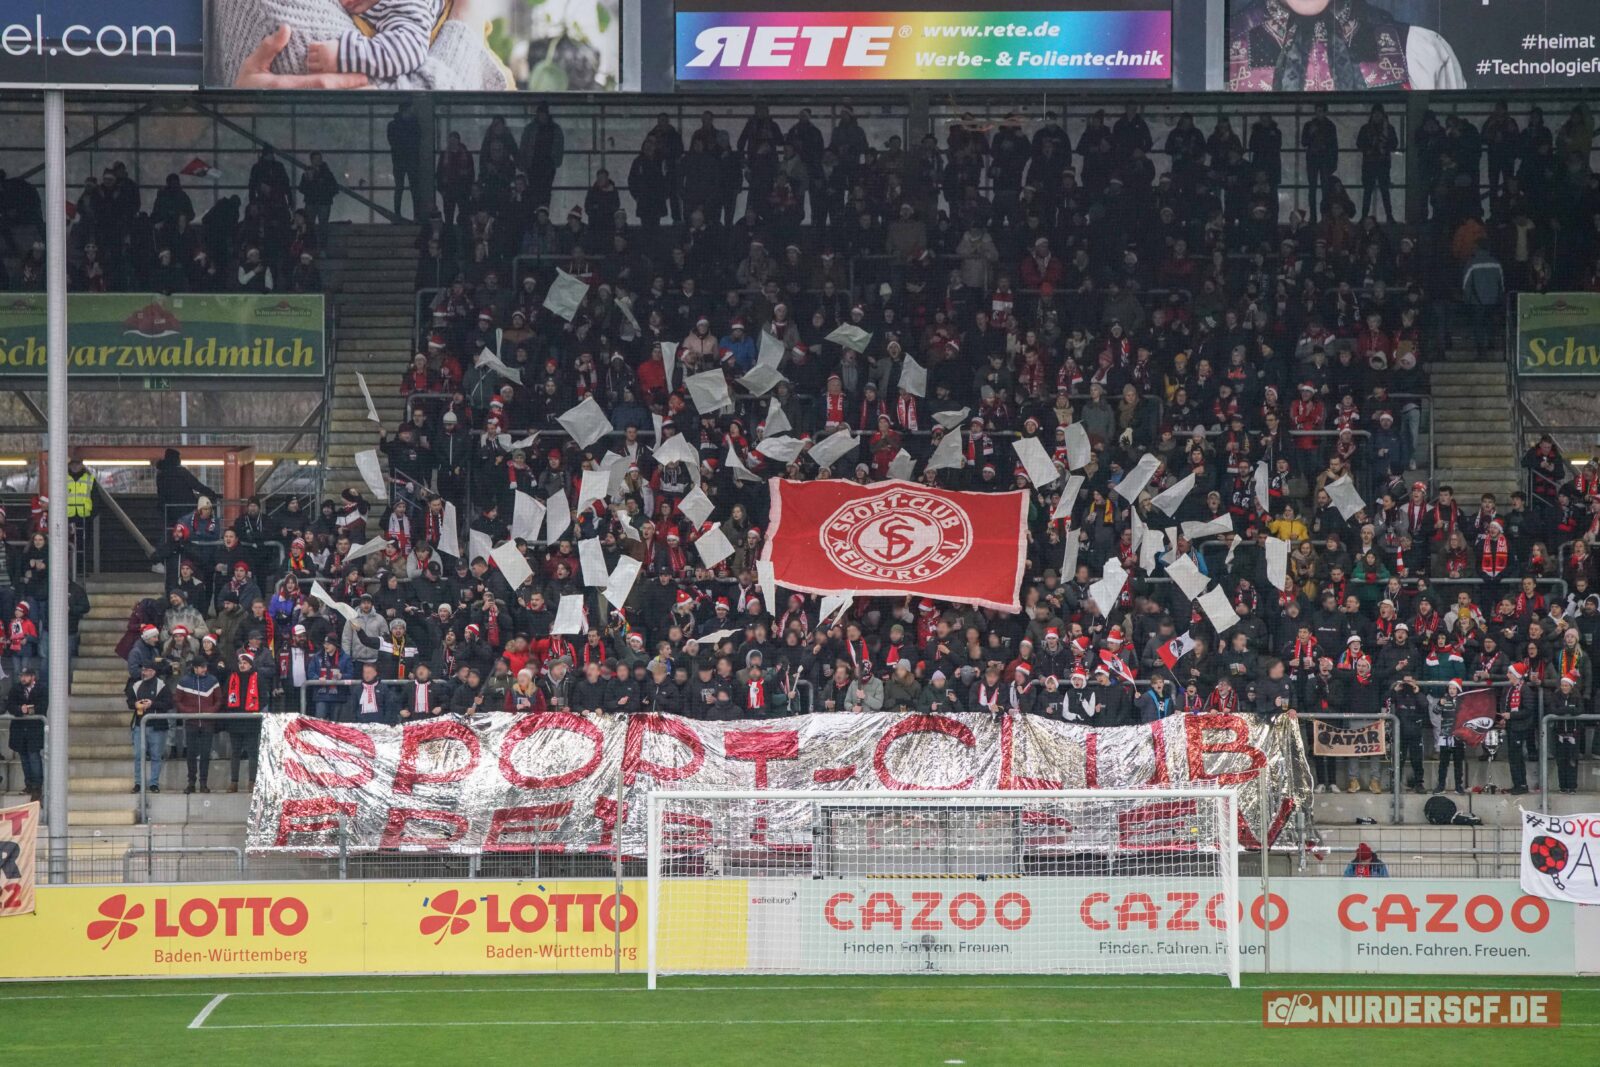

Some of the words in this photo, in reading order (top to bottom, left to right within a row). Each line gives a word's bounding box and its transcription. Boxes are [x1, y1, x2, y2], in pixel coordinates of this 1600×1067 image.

[923, 22, 1060, 38] www.rete.de
[1521, 34, 1595, 49] #heimat
[685, 26, 893, 66] RETE
[915, 51, 992, 68] Werbe-
[996, 51, 1012, 67] &
[1017, 49, 1164, 68] Folientechnik
[832, 494, 961, 533] SPORT-CLUB
[829, 536, 931, 580] REIBURG
[284, 712, 1268, 790] SPORT-CLUB
[1318, 730, 1380, 748] QATAR
[1354, 745, 1381, 753] 2022
[155, 897, 309, 937] LOTTO
[486, 894, 638, 933] LOTTO
[824, 892, 1032, 931] CAZOO
[1080, 892, 1289, 931] CAZOO
[1337, 893, 1550, 933] CAZOO
[154, 949, 307, 964] Baden-Württemberg
[843, 942, 897, 954] Finden.
[959, 942, 1013, 954] Freuen.
[1100, 942, 1153, 955] Finden.
[1157, 942, 1212, 955] Fahren.
[1215, 942, 1266, 955] Fruen
[1357, 944, 1412, 956] Finden.
[1416, 944, 1472, 957] Fahren.
[1475, 945, 1530, 957] Freuen.
